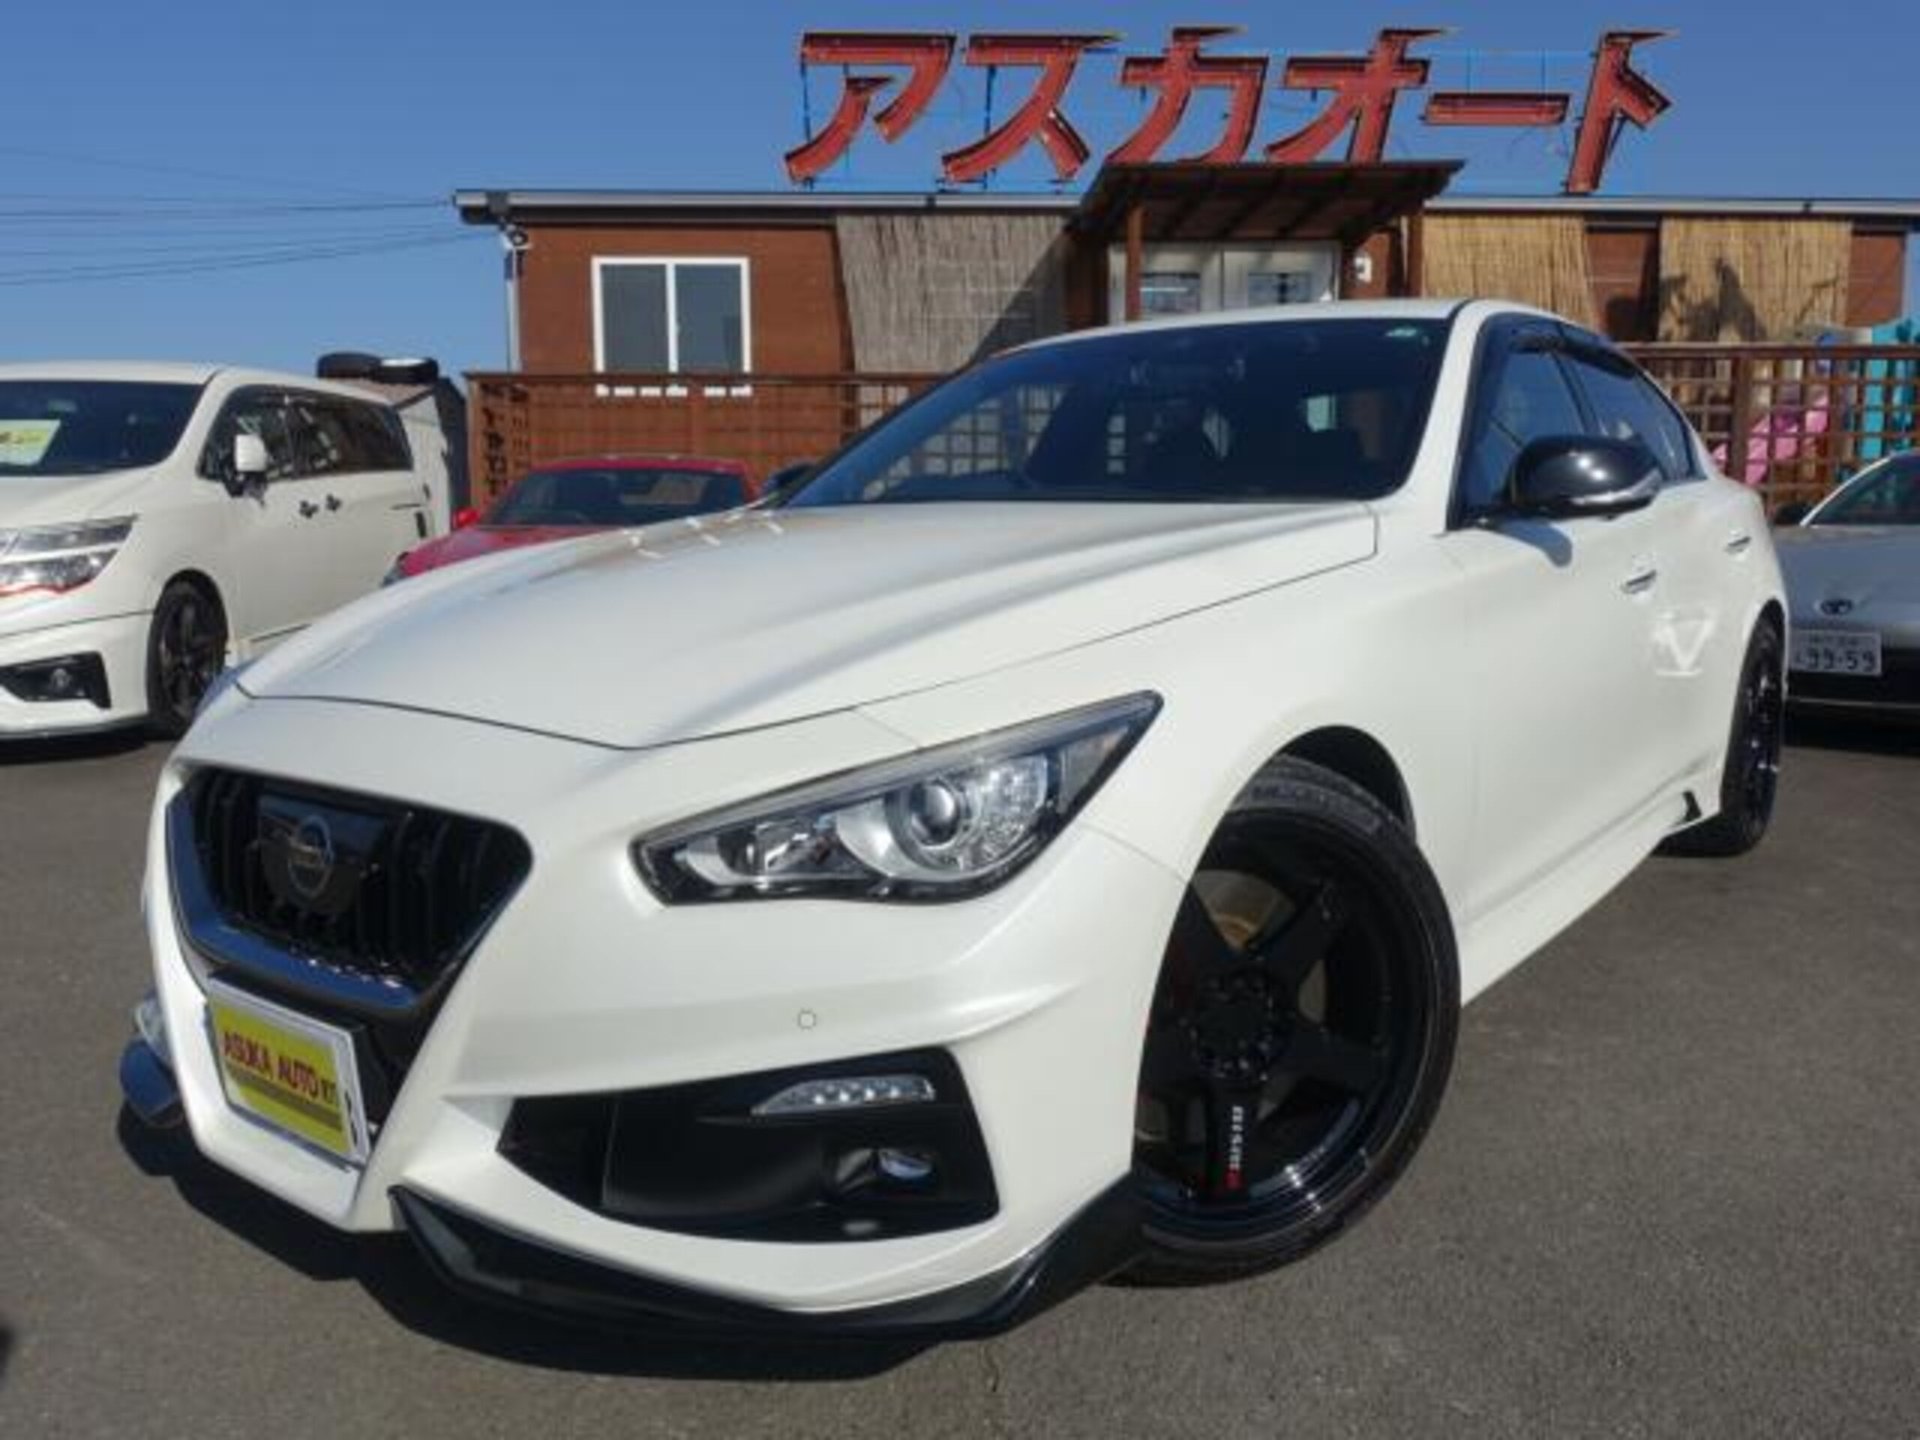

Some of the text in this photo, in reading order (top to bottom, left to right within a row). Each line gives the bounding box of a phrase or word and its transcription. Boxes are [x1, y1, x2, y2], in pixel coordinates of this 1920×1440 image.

[785, 27, 1672, 195] アスカオート
[278, 1055, 320, 1099] AUTO
